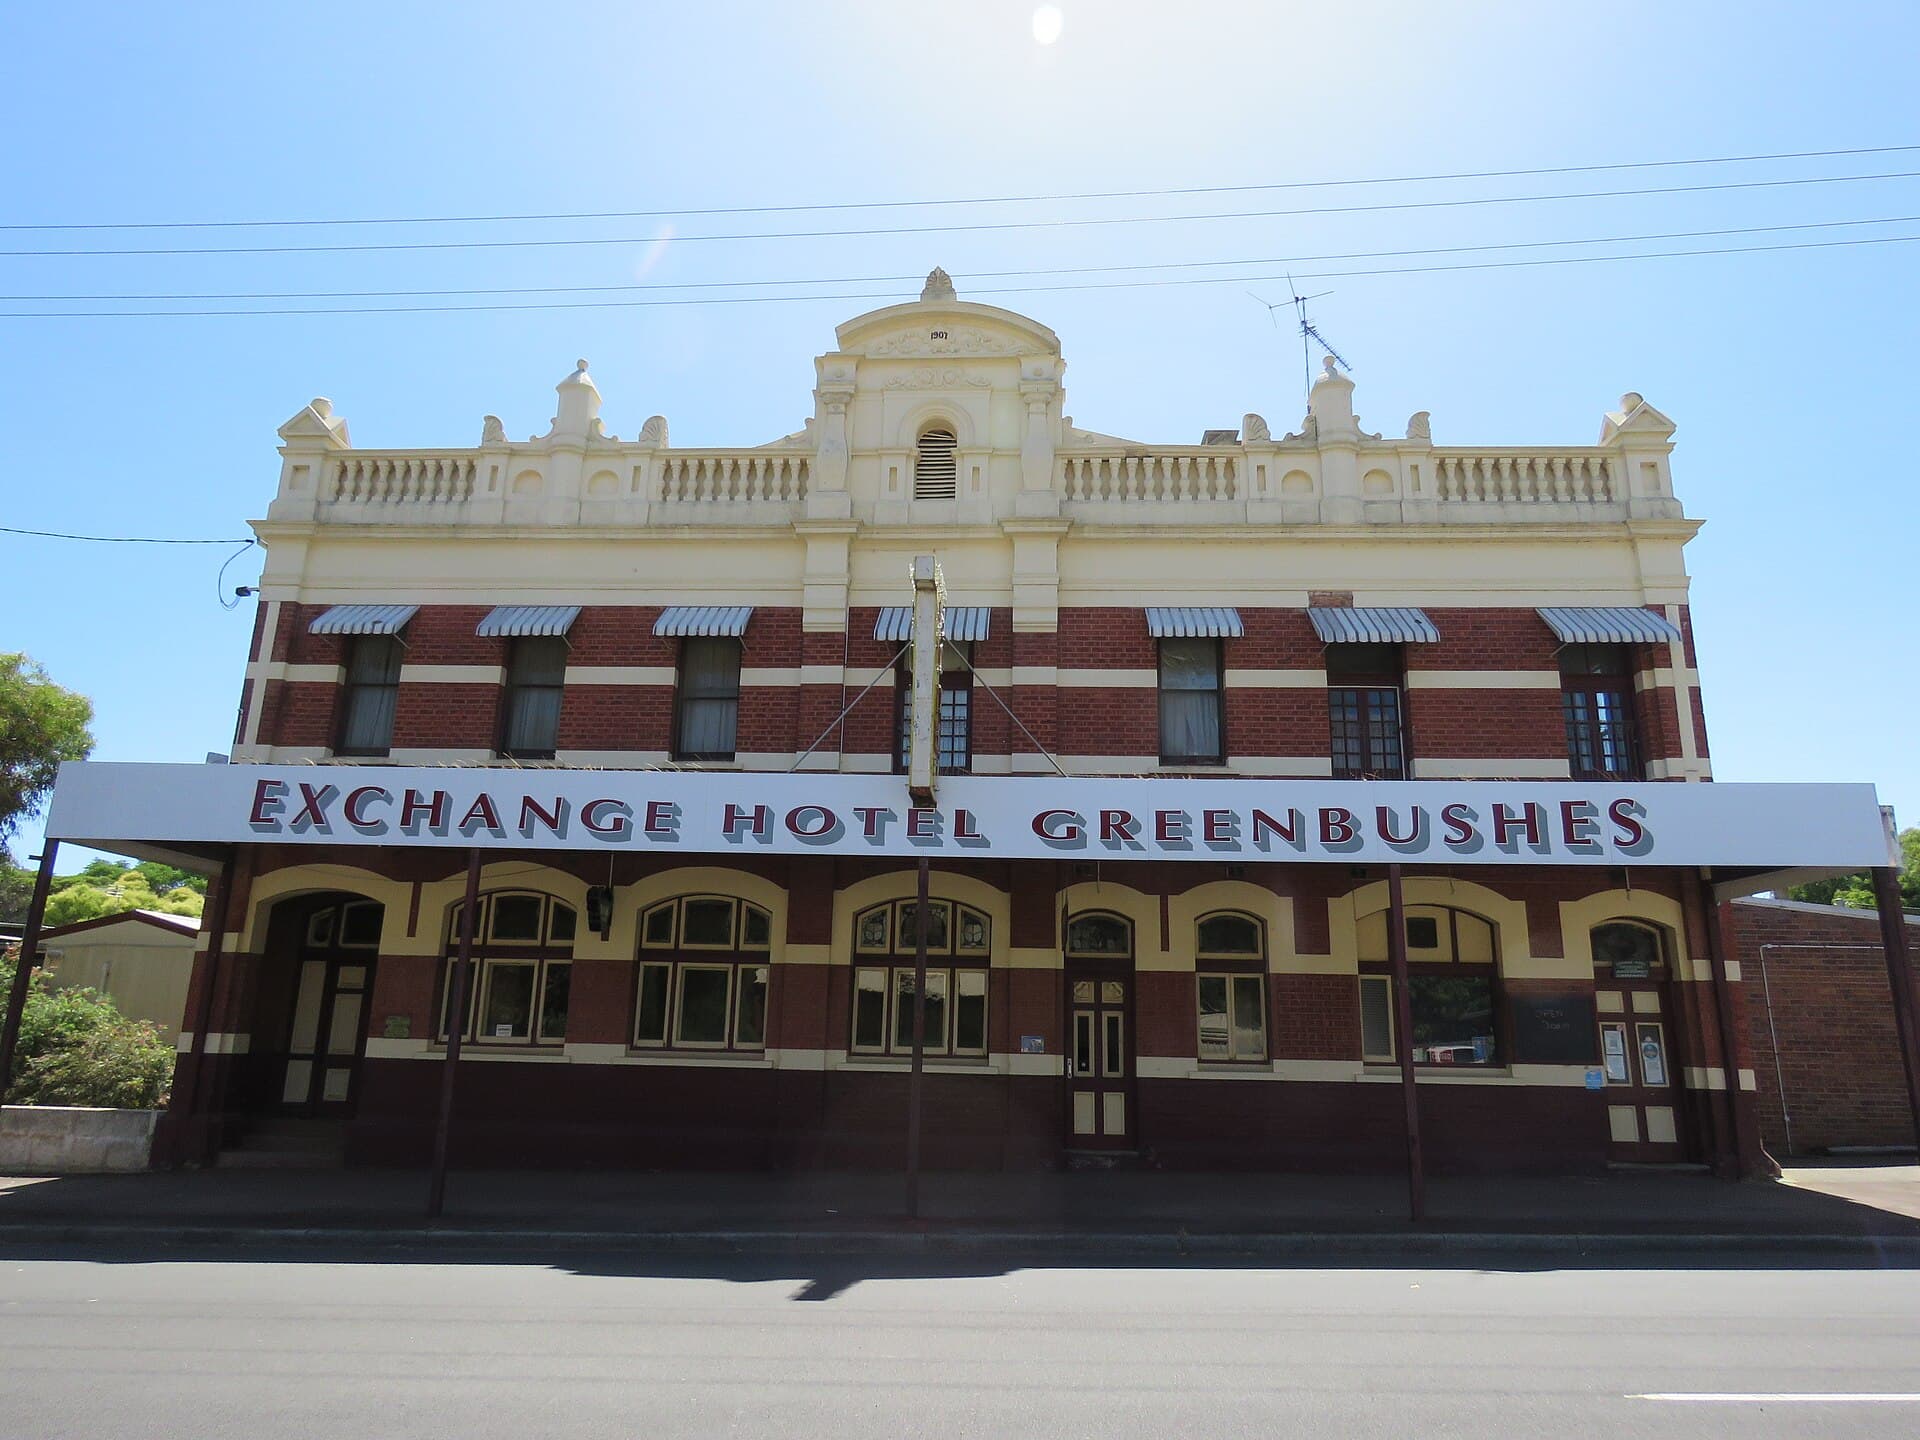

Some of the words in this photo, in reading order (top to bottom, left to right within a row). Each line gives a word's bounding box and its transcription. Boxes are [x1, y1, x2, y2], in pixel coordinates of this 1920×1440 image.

[930, 331, 948, 341] 1907
[248, 779, 682, 844] EXCHANGE
[722, 803, 993, 849] HOTEL
[1031, 799, 1655, 858] GREENBUSHES
